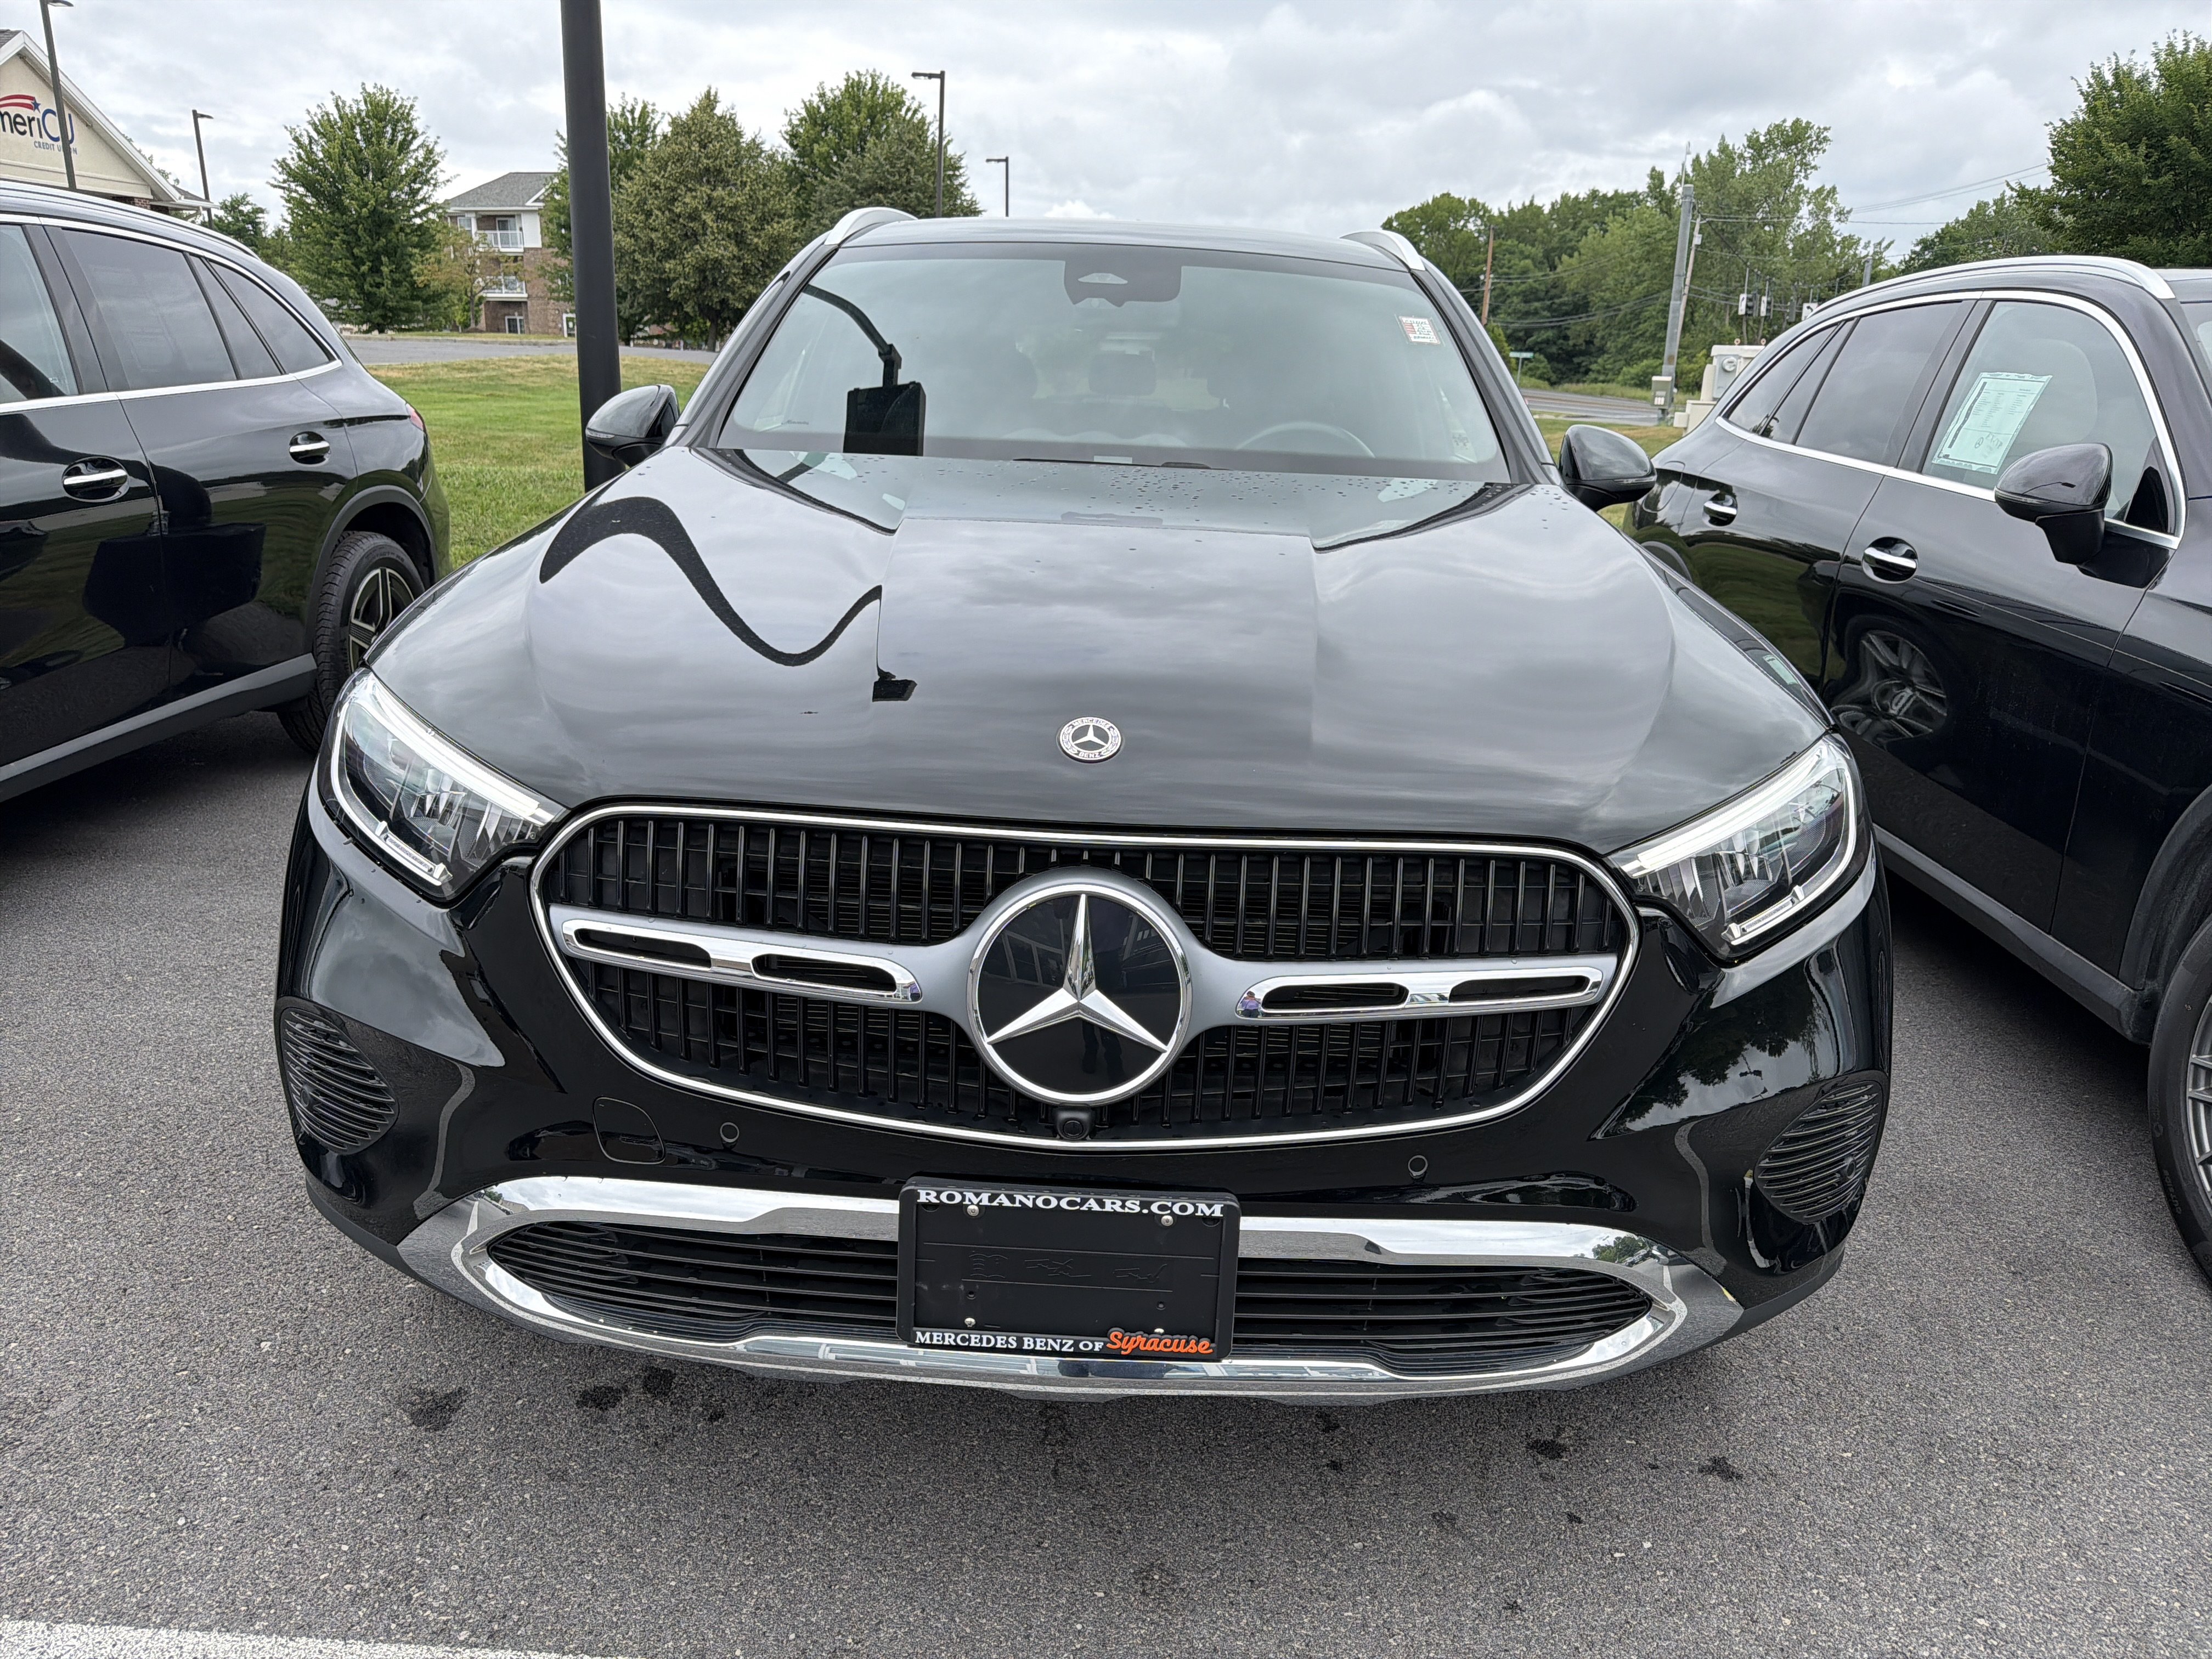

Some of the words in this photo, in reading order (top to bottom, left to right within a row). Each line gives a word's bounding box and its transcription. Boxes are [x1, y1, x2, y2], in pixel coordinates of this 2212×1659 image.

[33, 140, 55, 151] CREDIT
[917, 1189, 1224, 1217] ROMANOCARS.COM
[915, 1331, 1017, 1349] MERCEDES
[1022, 1337, 1074, 1352] BENZ
[1079, 1341, 1104, 1351] OF
[1106, 1331, 1213, 1355] Syracuse
